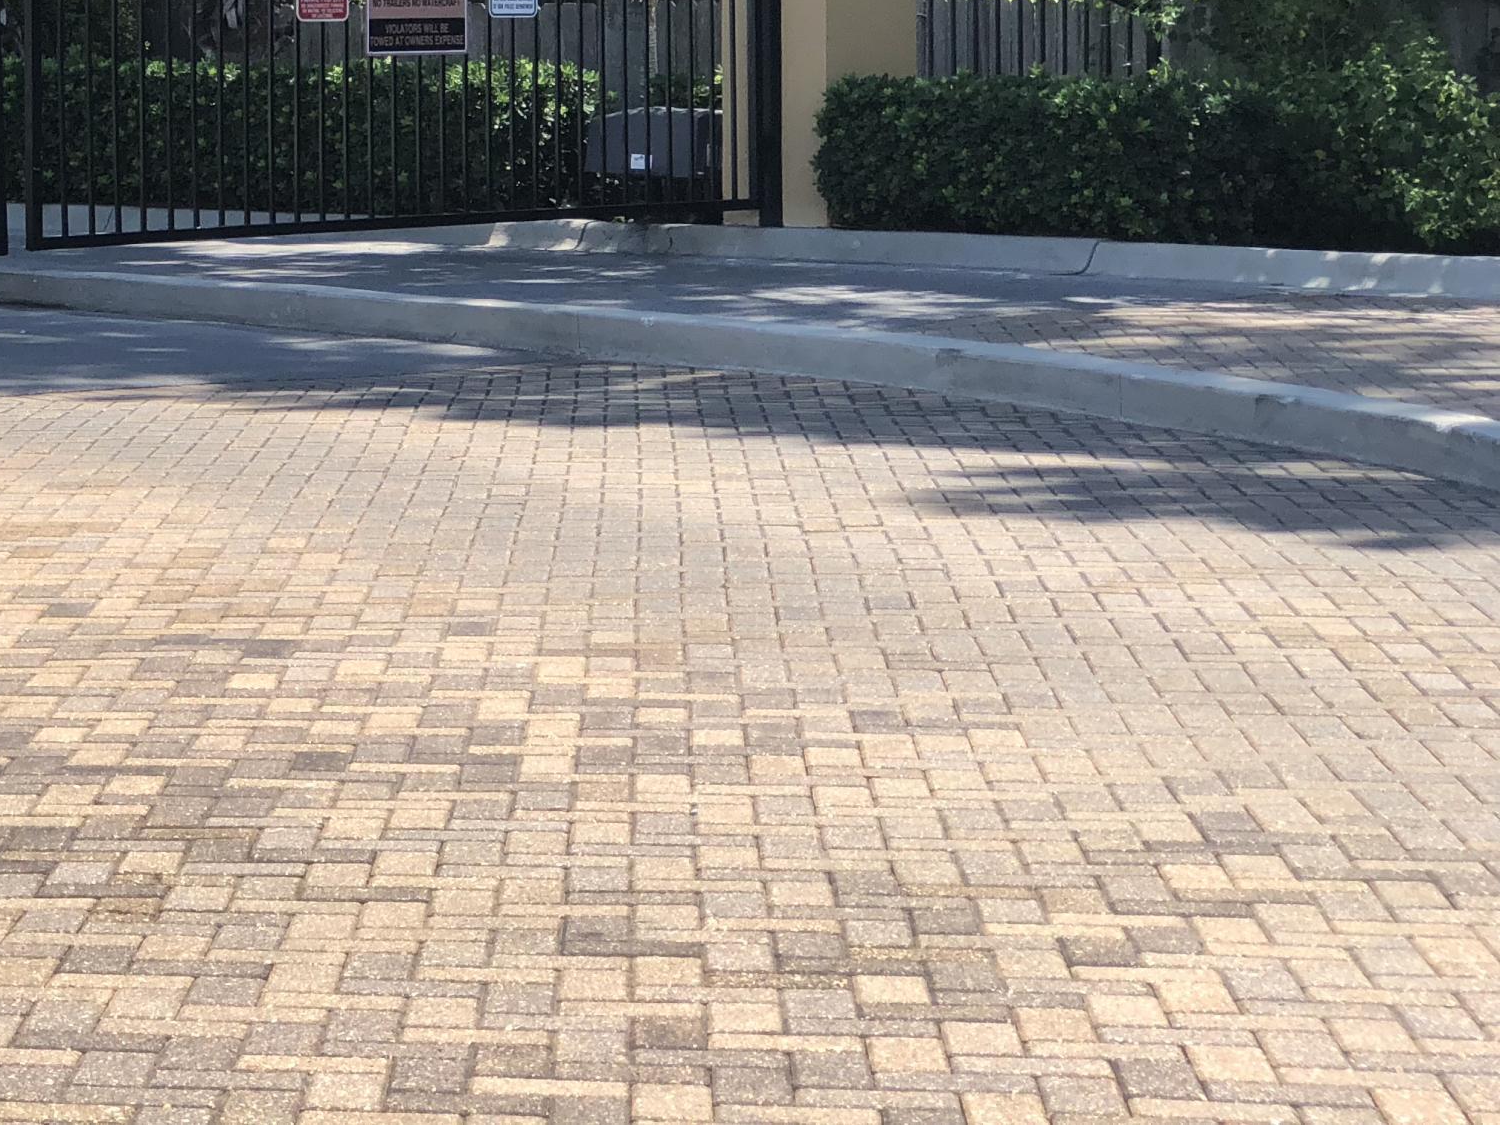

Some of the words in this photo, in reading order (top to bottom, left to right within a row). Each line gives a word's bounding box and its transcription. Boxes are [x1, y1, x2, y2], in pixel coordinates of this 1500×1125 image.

[385, 23, 422, 34] VIOLATORS
[423, 23, 439, 34] WILL
[440, 22, 450, 33] BE
[370, 36, 394, 47] TOWED
[395, 36, 404, 46] AT
[404, 35, 433, 46] OWNERS
[434, 34, 465, 45] EXPENSE
